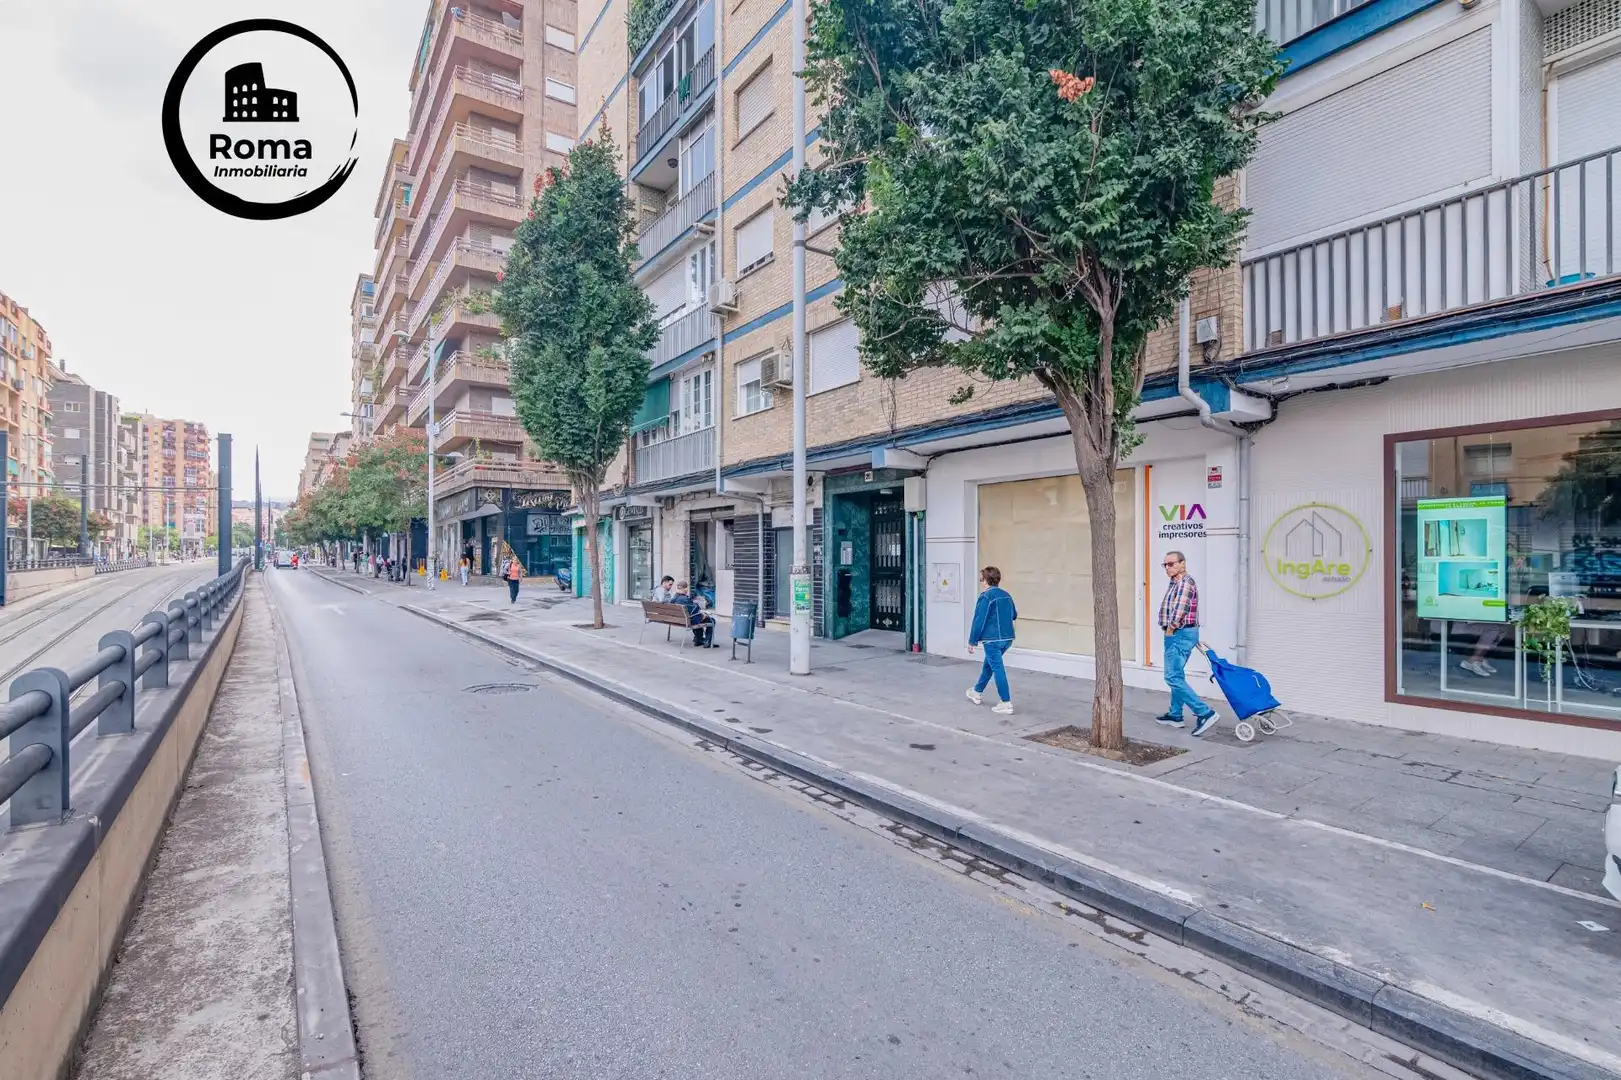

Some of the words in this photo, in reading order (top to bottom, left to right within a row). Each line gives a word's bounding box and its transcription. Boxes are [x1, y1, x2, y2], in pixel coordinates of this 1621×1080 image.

[1158, 503, 1207, 521] VIA
[1162, 521, 1204, 530] creativos
[1158, 531, 1207, 540] impresores
[1276, 559, 1352, 580] IngAre
